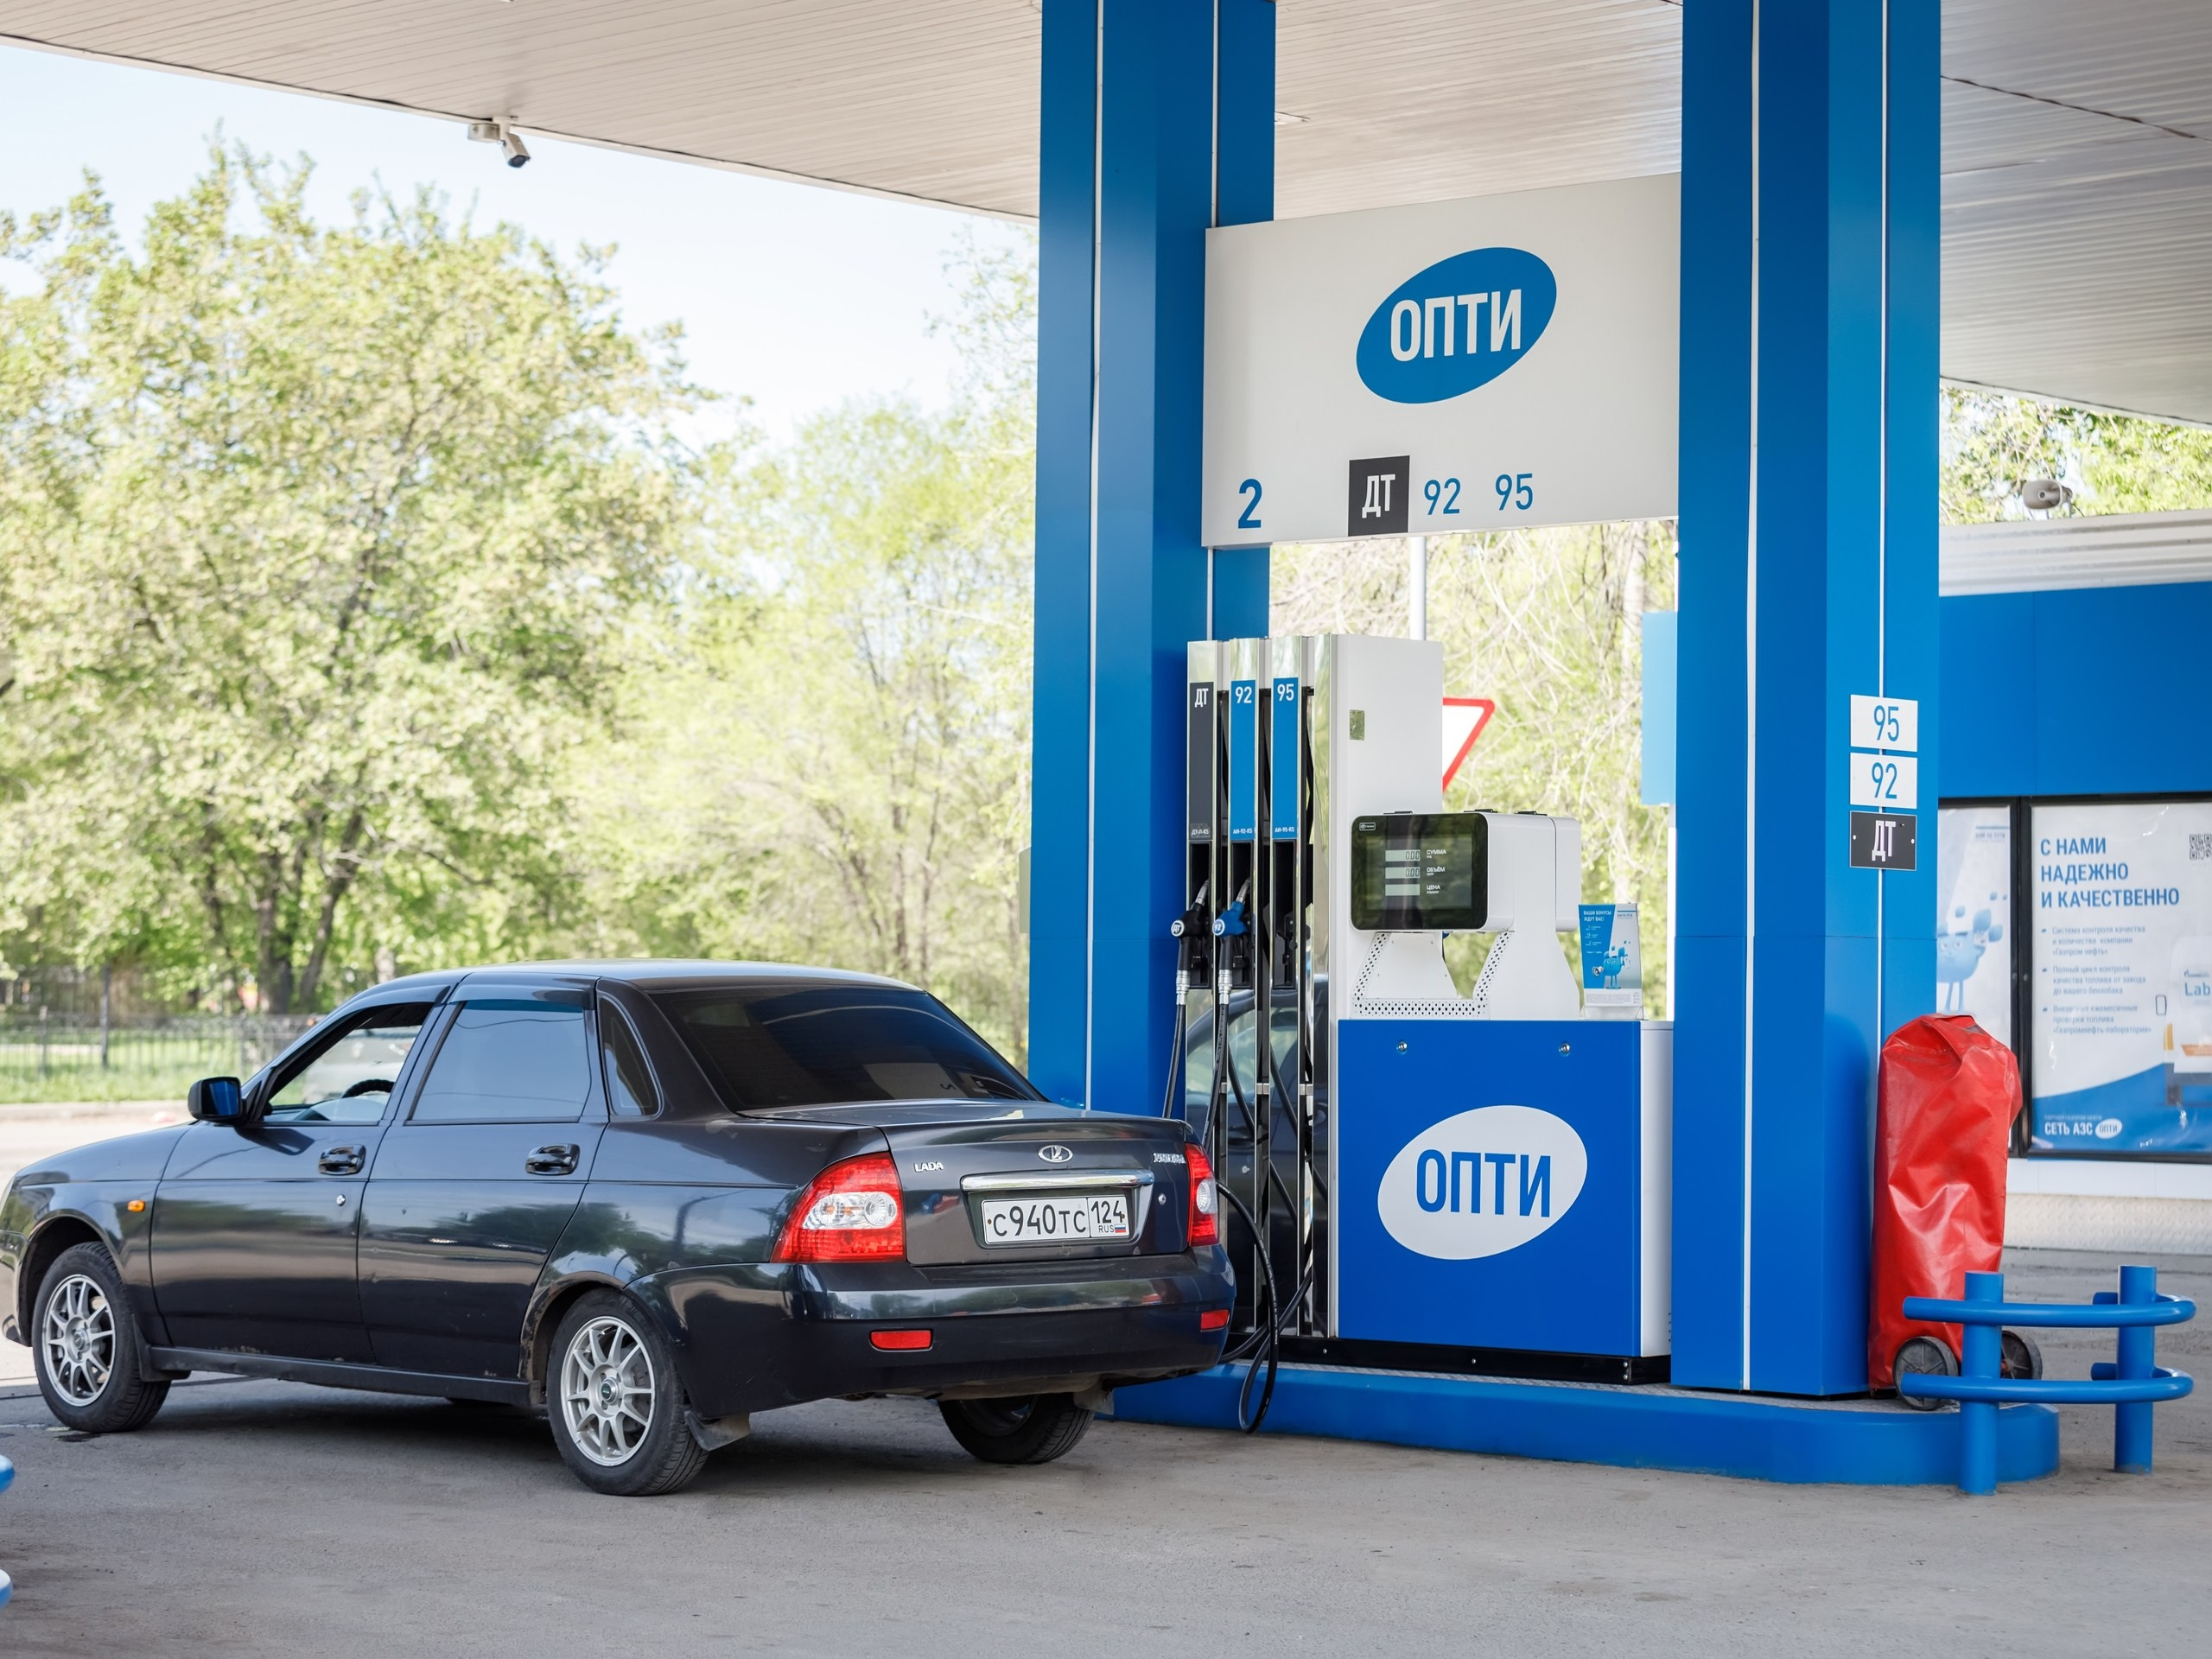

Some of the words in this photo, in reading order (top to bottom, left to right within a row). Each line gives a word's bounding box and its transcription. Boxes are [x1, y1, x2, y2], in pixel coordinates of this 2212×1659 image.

[1390, 289, 1522, 361] ОПТИ
[1237, 478, 1262, 529] 2
[1362, 474, 1395, 518] ДТ
[1423, 477, 1461, 516] 92
[1495, 473, 1534, 511] 95
[1194, 688, 1209, 708] ДТ
[1235, 686, 1252, 703] 92
[1277, 683, 1294, 702] 95
[1873, 705, 1899, 742] 95
[1872, 762, 1897, 799] 92
[1872, 820, 1897, 862] ДТ
[2040, 838, 2050, 855] С
[2056, 837, 2106, 855] НАМИ
[2041, 862, 2128, 885] НАДЕЖНО
[2041, 892, 2052, 908] И
[2057, 887, 2179, 908] КАЧЕСТВЕННО
[2082, 926, 2113, 935] контроля
[2114, 925, 2145, 934] качества
[2052, 965, 2079, 974] Полный
[2099, 966, 2131, 975] контроля
[2044, 1122, 2070, 1135] СЕТЬ
[2072, 1122, 2093, 1135] АЗС
[2098, 1124, 2118, 1134] ОПТИ
[913, 1161, 944, 1173] LADA
[1416, 1148, 1551, 1218] ОПТИ
[1091, 1200, 1124, 1224] 124
[1098, 1224, 1115, 1233] RUS
